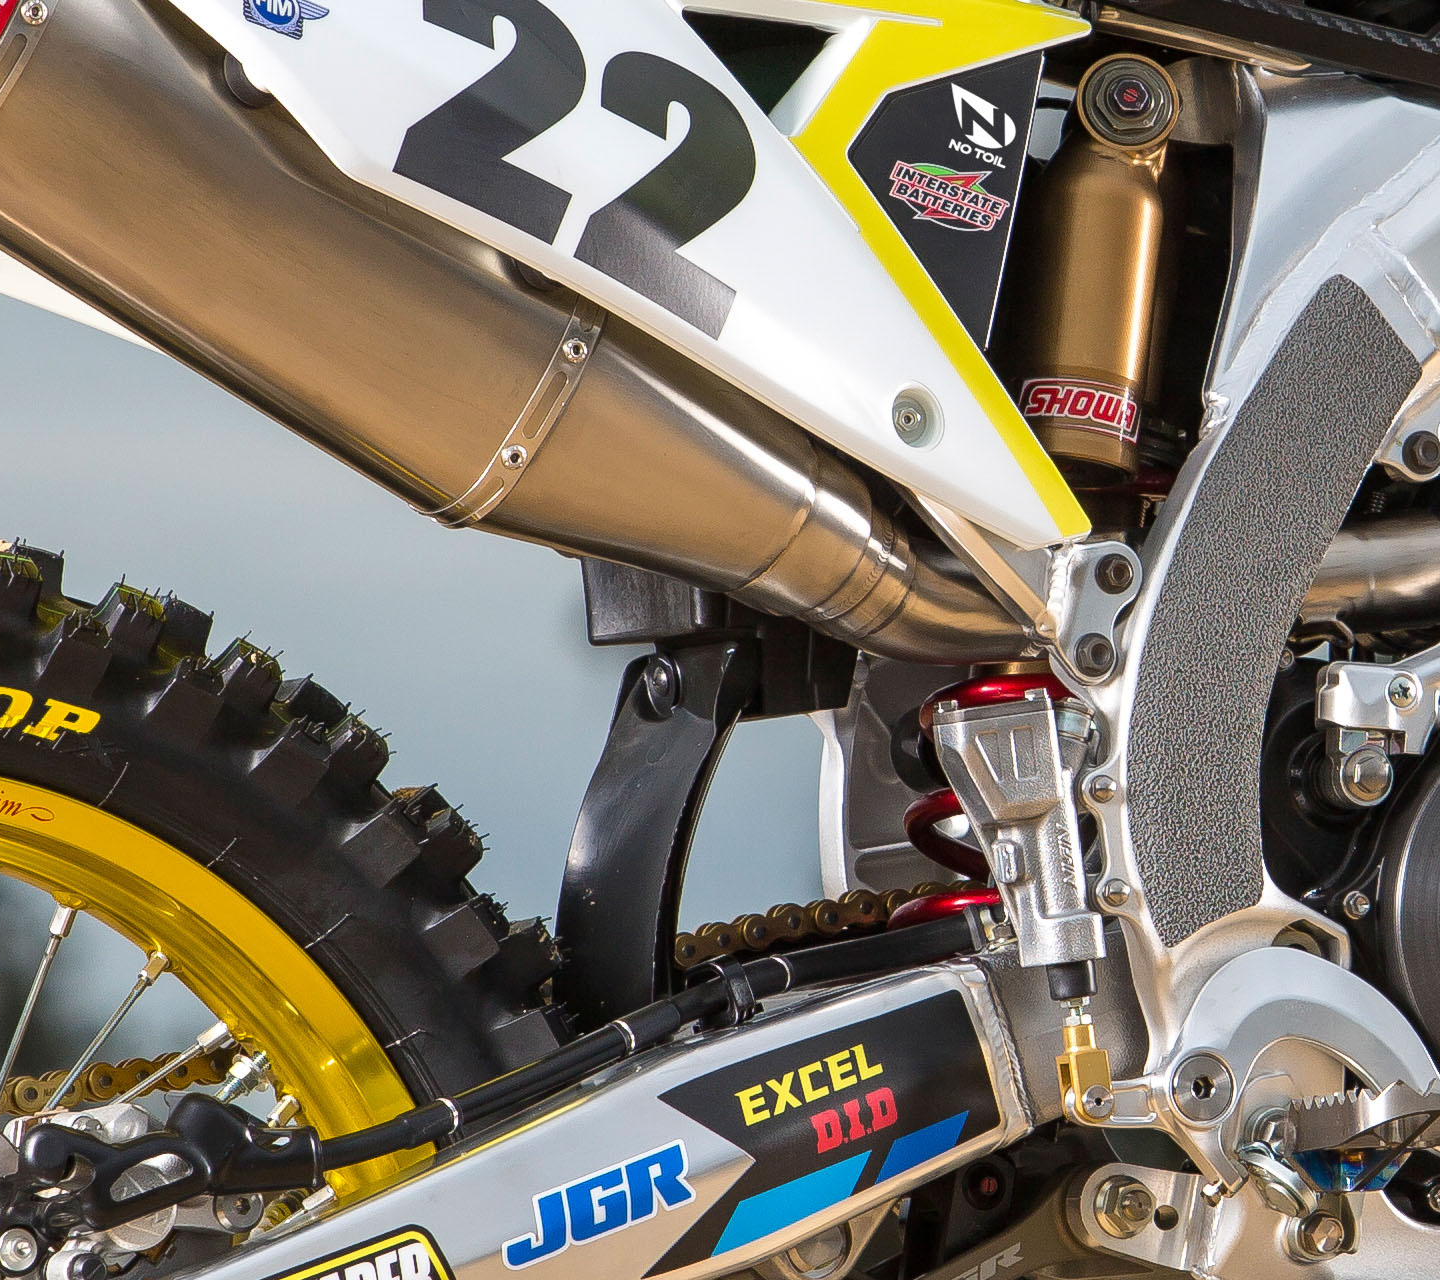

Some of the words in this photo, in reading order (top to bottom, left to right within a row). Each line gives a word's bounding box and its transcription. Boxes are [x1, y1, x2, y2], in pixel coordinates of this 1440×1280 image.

[948, 138, 972, 155] NO
[974, 147, 1007, 169] TOIL
[895, 166, 1004, 216] INTERSTATE
[895, 181, 995, 228] BATTERIES
[1024, 386, 1138, 434] SHOWA
[733, 1043, 884, 1127] EXCEL
[810, 1086, 898, 1154] D.I.D
[504, 1141, 696, 1269] JGR
